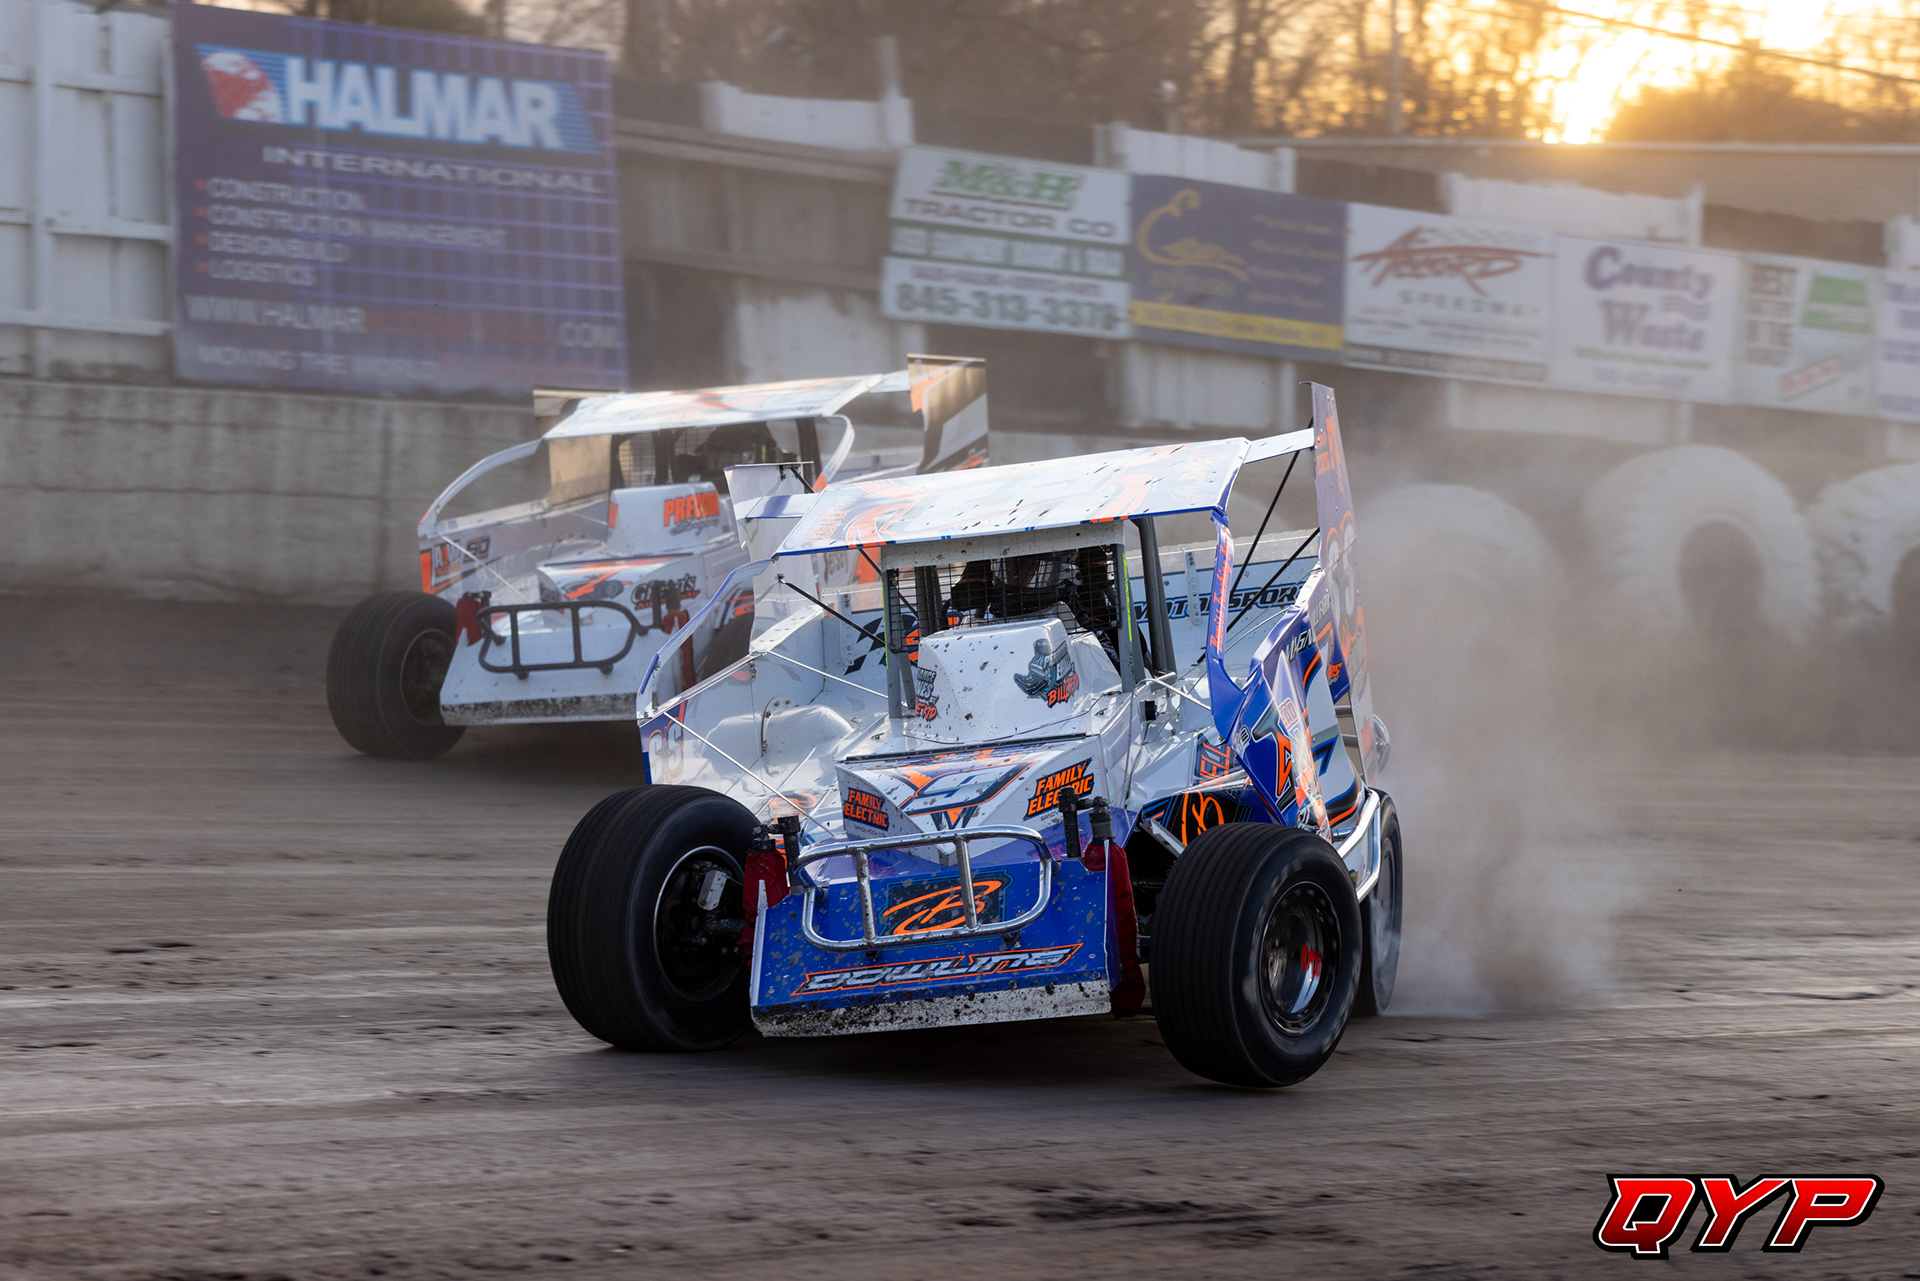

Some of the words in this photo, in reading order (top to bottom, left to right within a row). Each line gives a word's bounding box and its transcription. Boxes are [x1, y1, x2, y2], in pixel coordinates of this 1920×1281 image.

[283, 58, 563, 150] HALMAR
[261, 146, 605, 194] INTERNATIONAL
[937, 159, 1079, 203] M&H
[206, 177, 366, 211] CONSTRUCTION
[206, 204, 365, 236] CONSTRUCTION
[367, 219, 507, 248] MANAGEMENT
[905, 199, 1055, 232] TRACTOR
[207, 258, 316, 287] LOGISTICS
[1584, 246, 1714, 301] County
[1600, 300, 1706, 352] Waste
[1035, 761, 1088, 797] FAMILY
[844, 802, 888, 828] ELECTRIC
[848, 790, 881, 811] FAMILY
